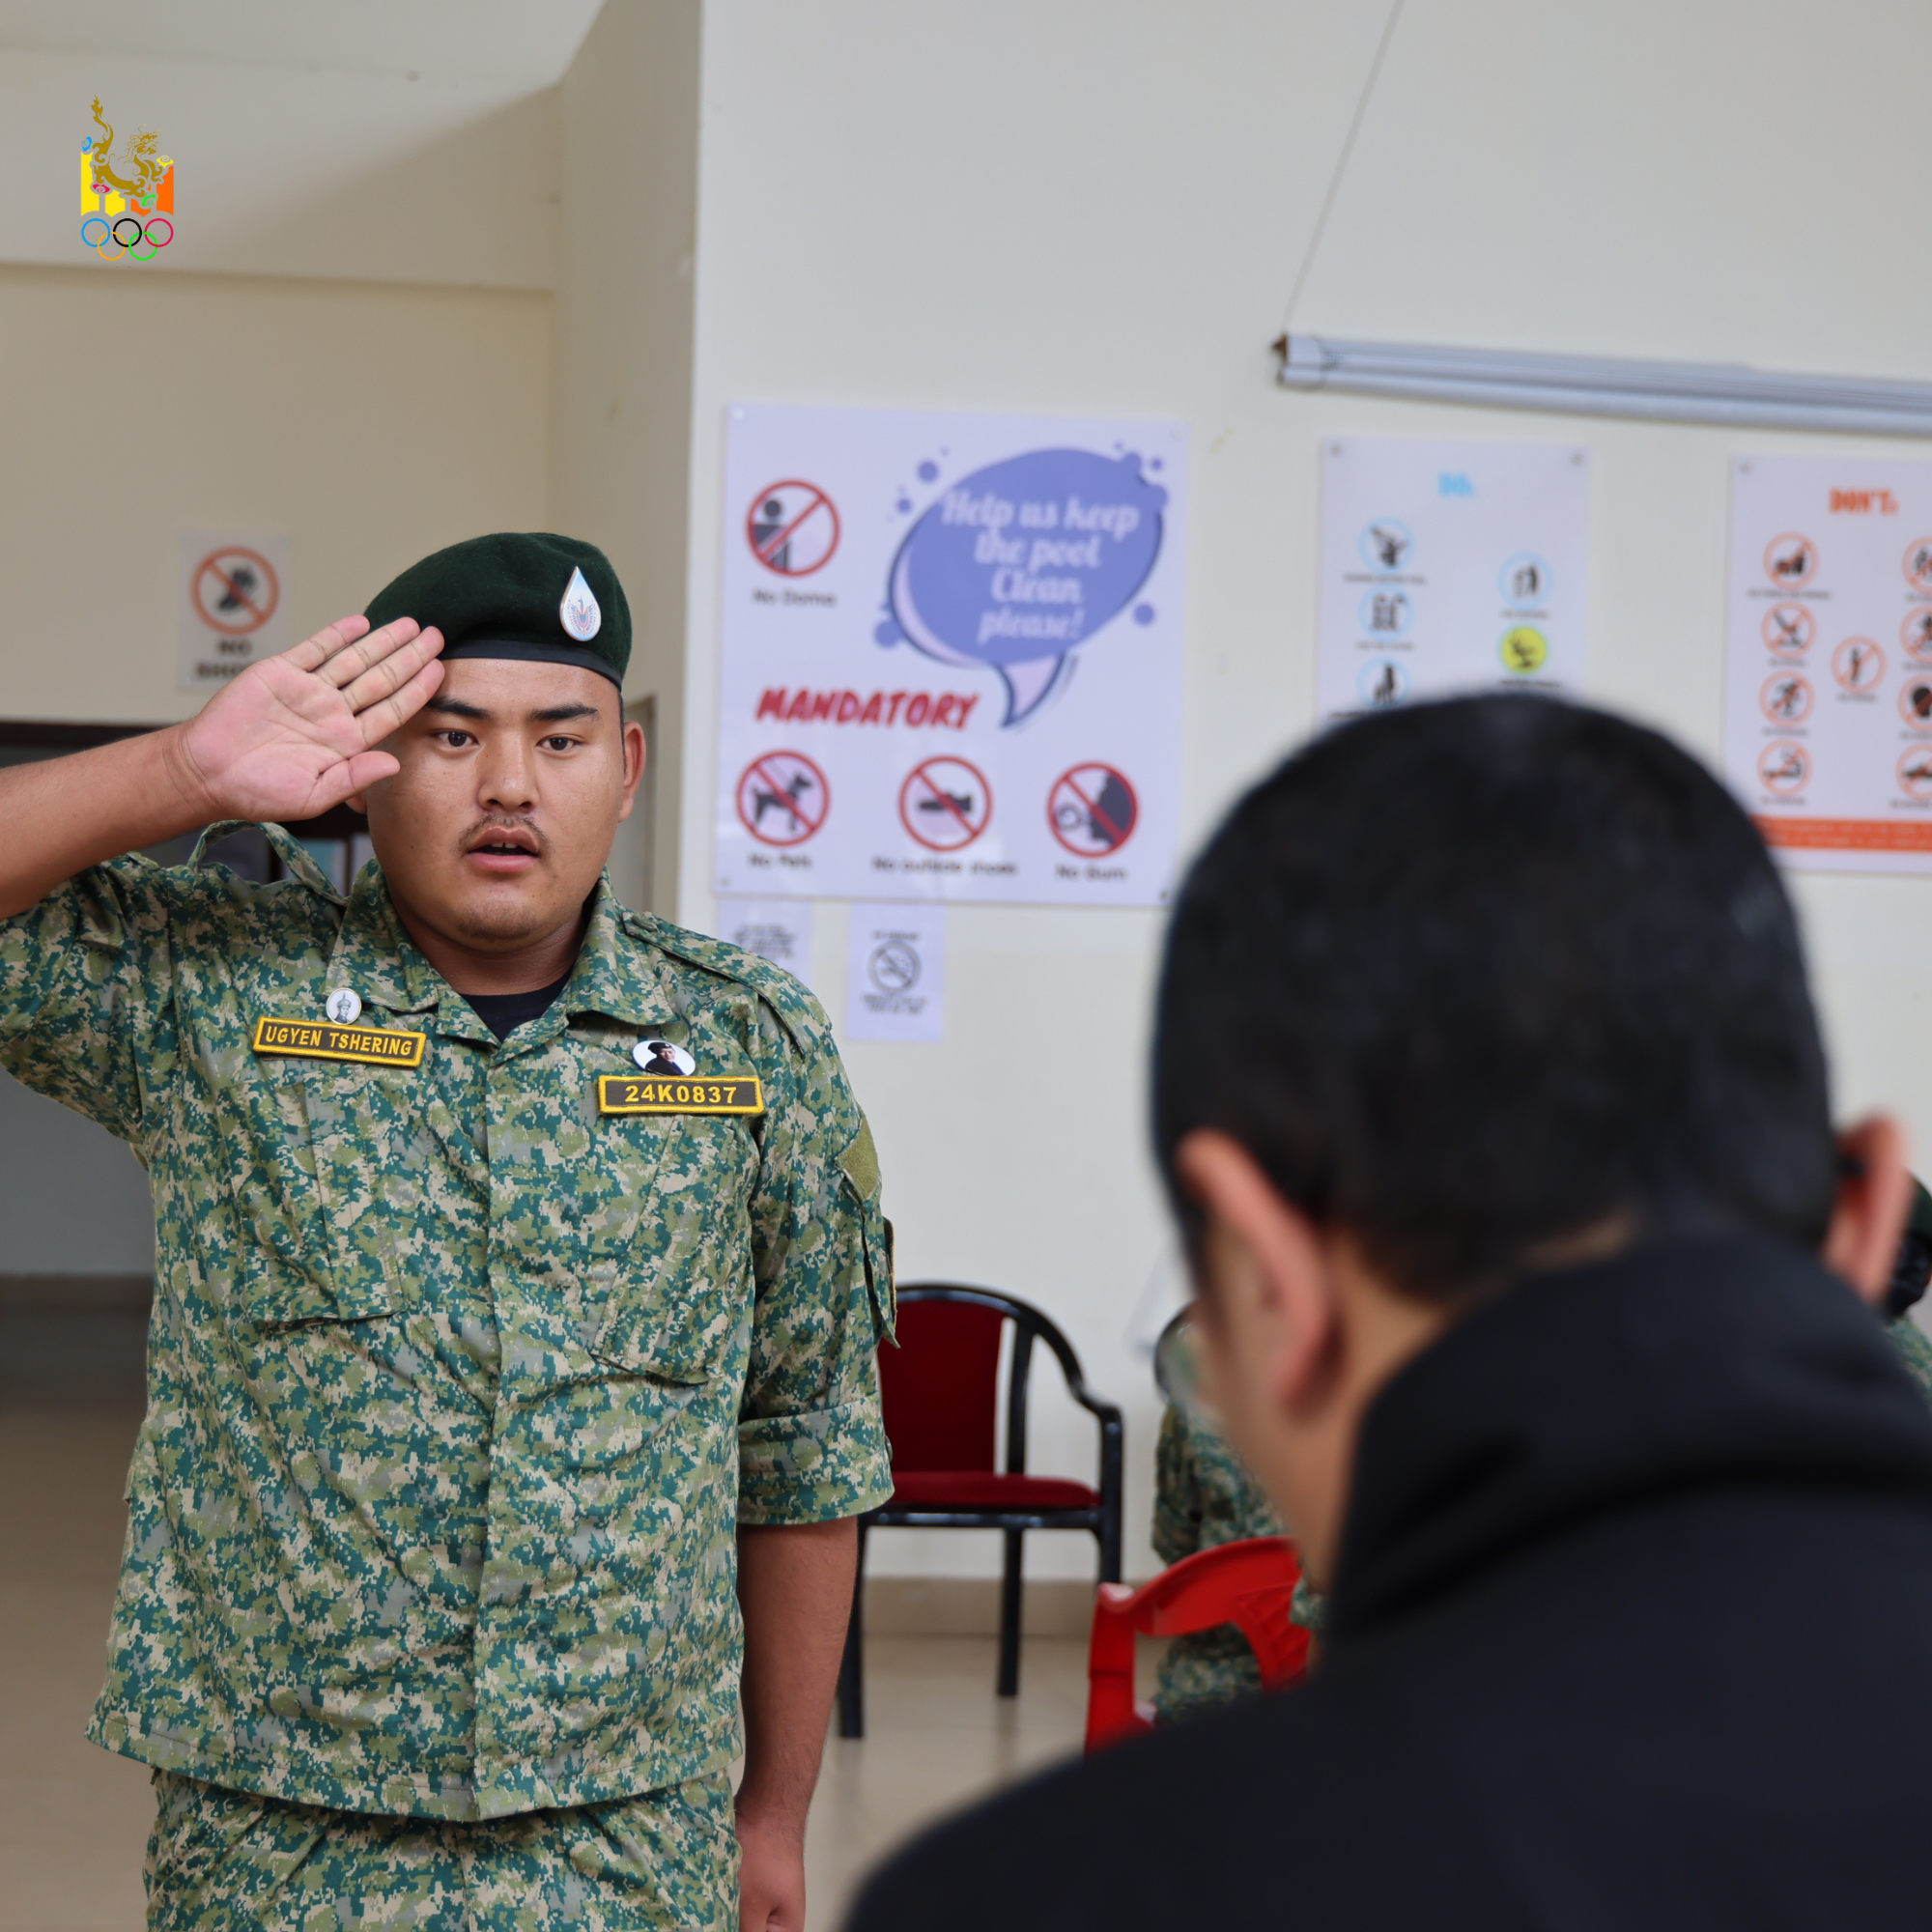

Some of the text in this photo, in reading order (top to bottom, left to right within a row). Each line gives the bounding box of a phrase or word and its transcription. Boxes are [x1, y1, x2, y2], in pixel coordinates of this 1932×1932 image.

[942, 491, 1141, 542] Help us keep
[974, 529, 1026, 564] the
[752, 588, 776, 606] No
[990, 566, 1084, 604] Clean
[977, 607, 1085, 645] please!
[217, 639, 251, 655] NO
[756, 689, 979, 730] MANDATORY
[749, 852, 772, 868] No
[872, 857, 895, 873] No
[1055, 864, 1079, 880] No
[266, 1026, 412, 1056] UGYEN TSHERING
[625, 1084, 737, 1103] 24K0837
